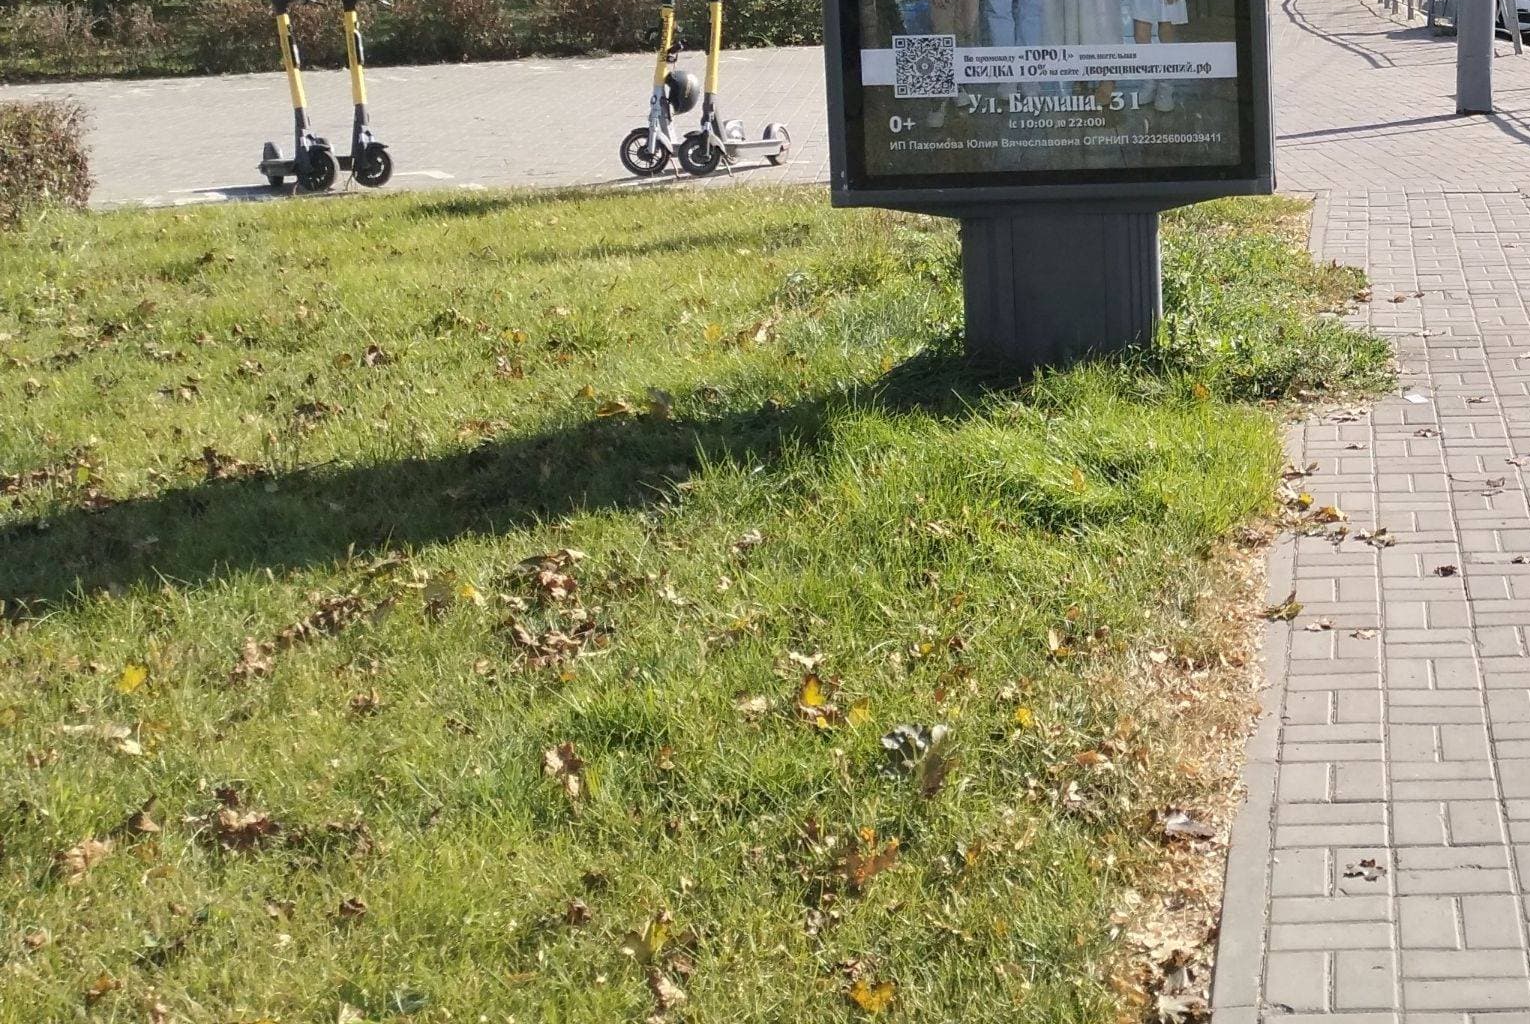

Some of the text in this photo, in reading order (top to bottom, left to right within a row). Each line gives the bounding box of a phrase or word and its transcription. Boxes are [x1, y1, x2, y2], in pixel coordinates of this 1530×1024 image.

[964, 65, 1014, 78] СКИДКА
[1020, 64, 1048, 76] 10%
[1060, 68, 1079, 76] сайте
[1082, 62, 1212, 77] дворецвпечатлений.рф
[968, 94, 1002, 114] Ул.
[1109, 91, 1141, 111] 31
[889, 115, 916, 133] 0+
[1020, 119, 1054, 129] 10:00
[890, 141, 906, 151] ИП
[909, 139, 964, 151] Пахомова
[966, 139, 998, 149] Юлия
[1001, 136, 1081, 149] Вячеславовна
[1083, 135, 1129, 146] ОГРНИП
